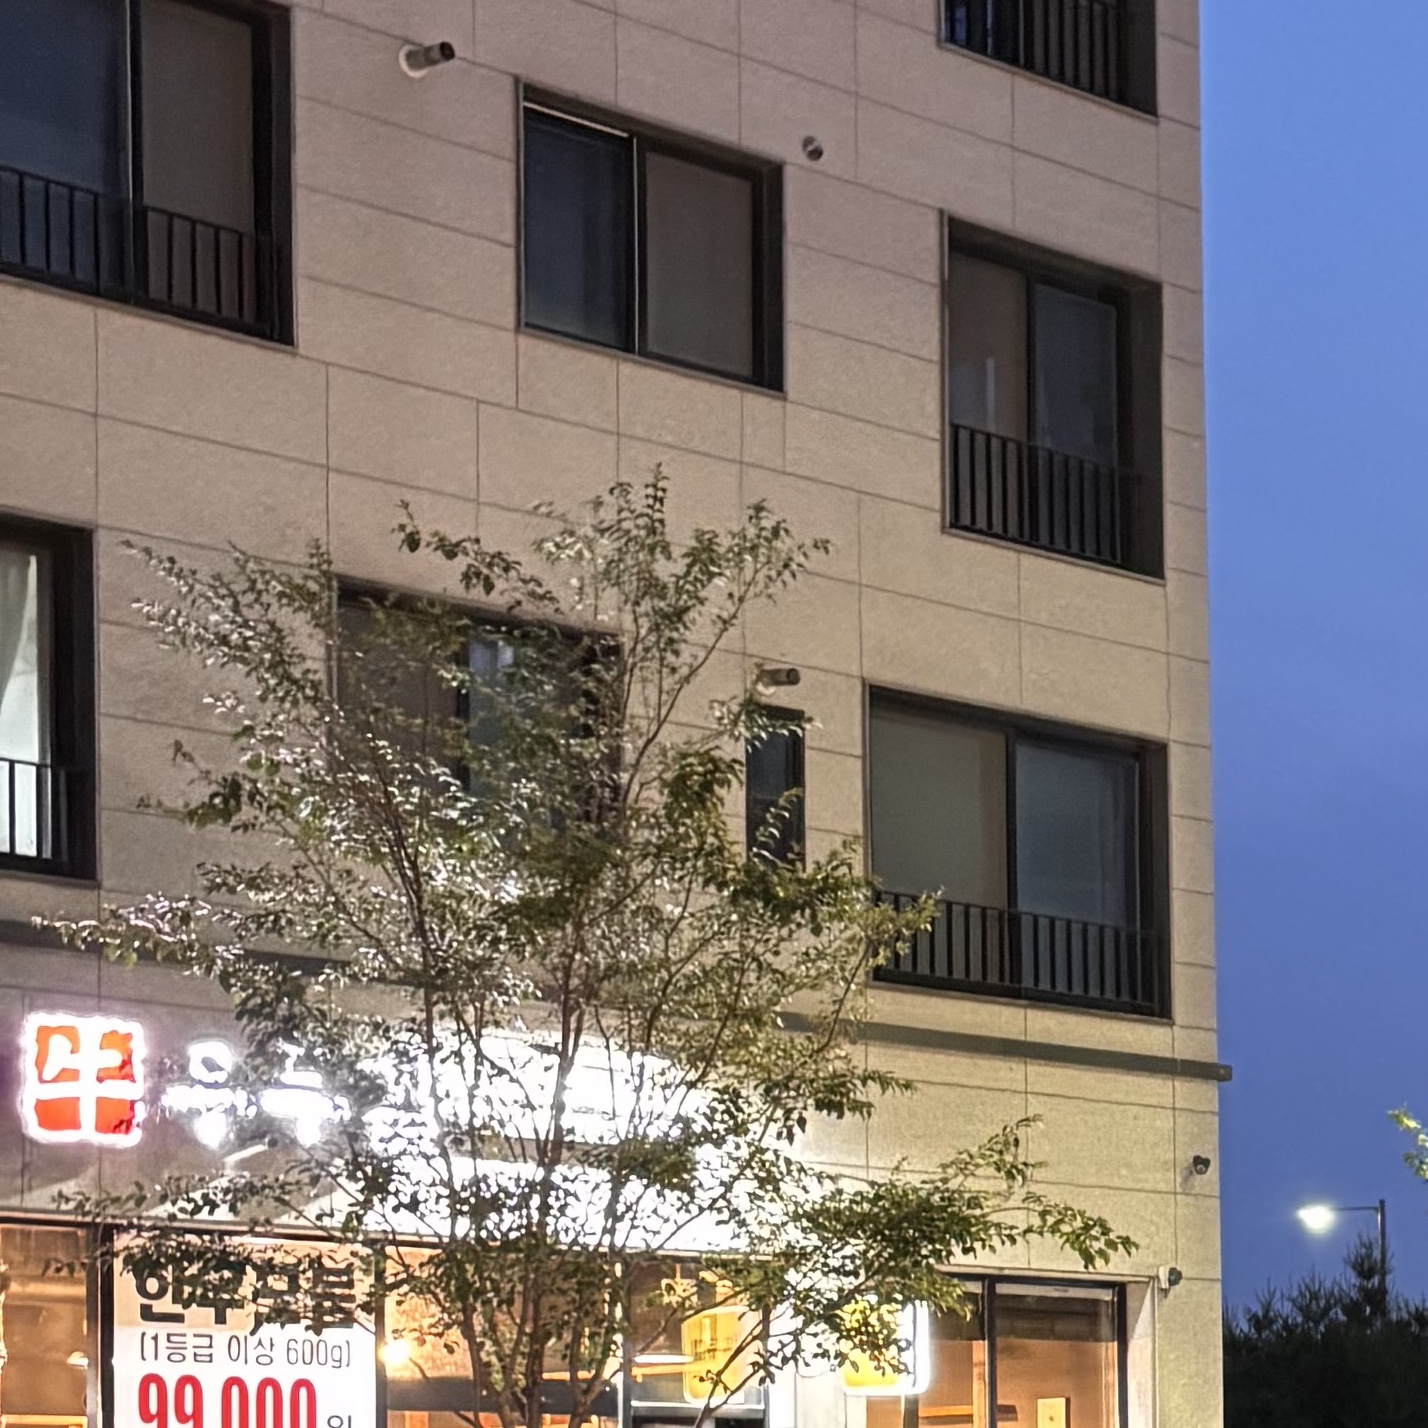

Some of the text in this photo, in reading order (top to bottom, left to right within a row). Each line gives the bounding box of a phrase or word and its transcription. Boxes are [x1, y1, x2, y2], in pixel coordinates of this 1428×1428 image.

[140, 1332, 351, 1368] (1등급 이상 600g)
